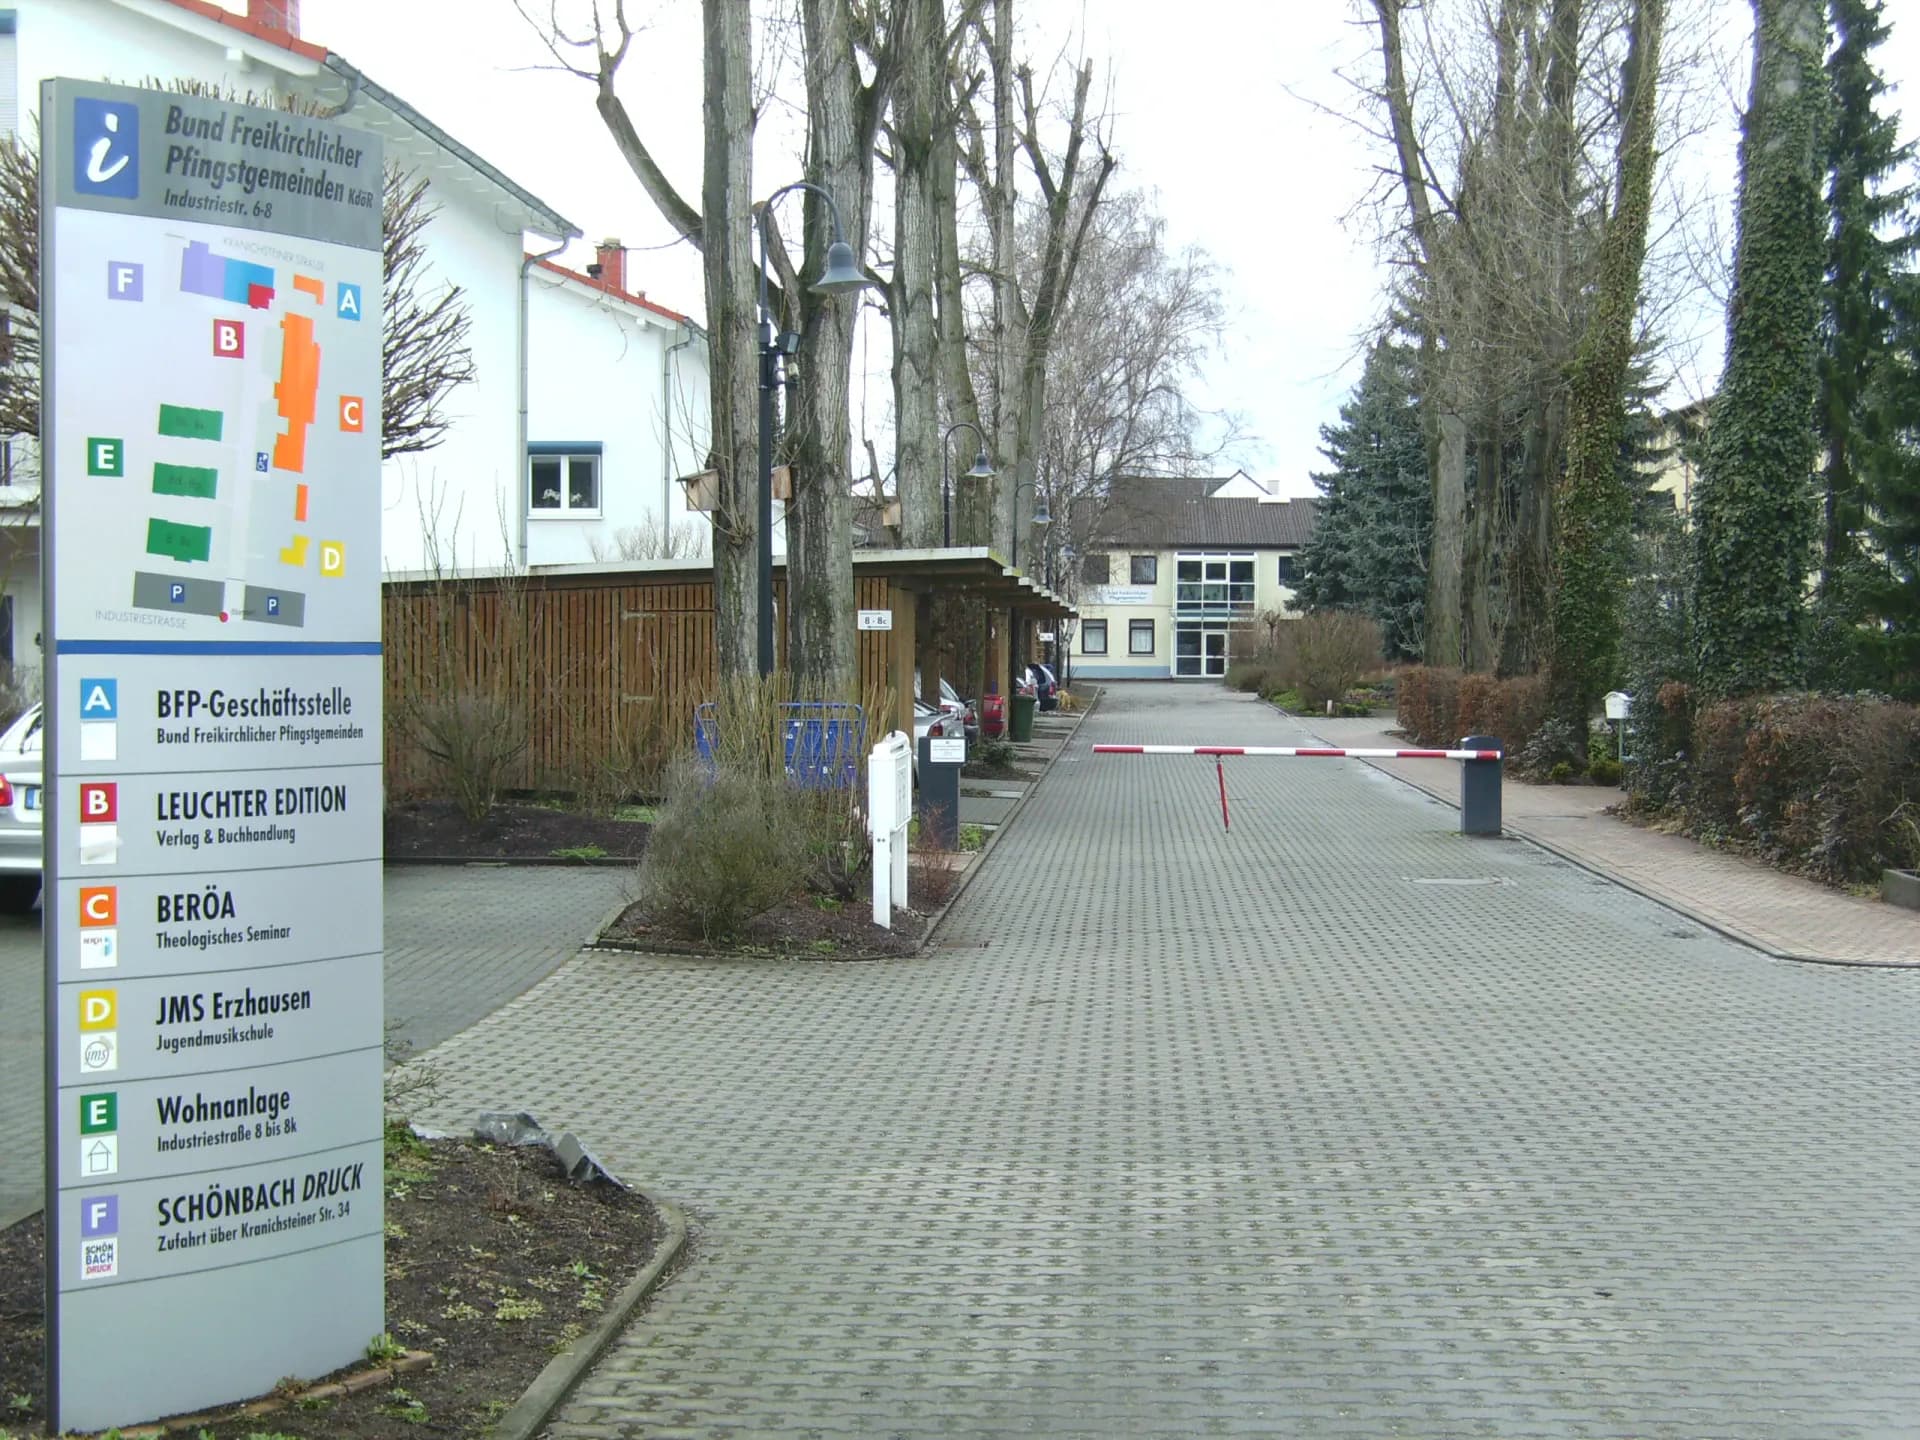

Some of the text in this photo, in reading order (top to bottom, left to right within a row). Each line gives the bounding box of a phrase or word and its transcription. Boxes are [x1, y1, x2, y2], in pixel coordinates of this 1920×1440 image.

[165, 105, 363, 169] Bund Freikirchlicher
[165, 145, 374, 209] Pfingstgemeinden KdöR
[164, 188, 273, 219] Industriestr. 6-8
[117, 269, 133, 293] F
[340, 289, 358, 314] A
[220, 326, 238, 351] B
[344, 402, 359, 426] C
[98, 445, 114, 470] E
[324, 548, 340, 570] D
[173, 585, 183, 599] P
[268, 598, 277, 612] P
[95, 610, 187, 629] INDUSTRIESTRASSE
[84, 685, 112, 711] A
[157, 687, 351, 718] BFP-Geschäftsstelle
[157, 723, 363, 745] Bund Freikirchlicher Pfingstgemeinden
[88, 790, 109, 815] B
[157, 785, 346, 821] LEUCHTER EDITION
[156, 824, 295, 849] Verlag & Buchhandlung
[86, 894, 109, 919] C
[157, 885, 235, 923] BERÖA
[156, 925, 291, 950] Theologisches Seminar
[86, 998, 110, 1022] D
[156, 988, 311, 1025] JMS Erzhausen
[156, 1023, 274, 1053] Jugendmusikschule
[90, 1100, 107, 1126] E
[157, 1086, 290, 1125] Wohnanlage
[157, 1117, 297, 1152] Industriestraße 8 bis 8k
[158, 1163, 364, 1227] SCHÖNBACH DRUCK
[91, 1203, 107, 1229] F
[158, 1201, 350, 1252] Zufahrt über Kranichsteiner Str. 34
[86, 1252, 113, 1265] BACH
